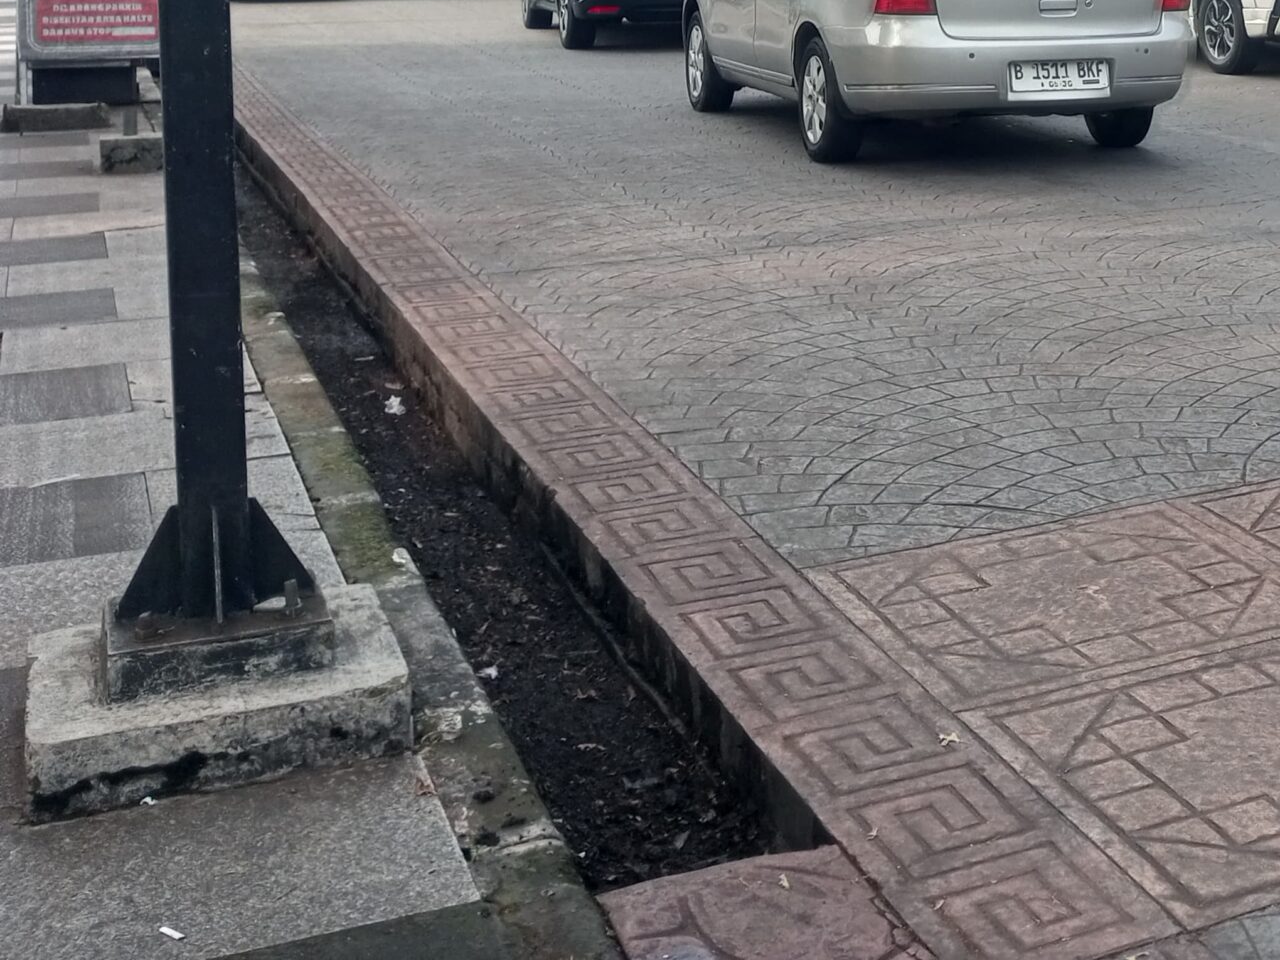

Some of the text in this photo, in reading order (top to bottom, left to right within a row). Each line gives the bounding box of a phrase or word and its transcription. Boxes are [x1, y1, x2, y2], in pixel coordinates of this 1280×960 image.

[1014, 60, 1105, 80] B 1511 BKF
